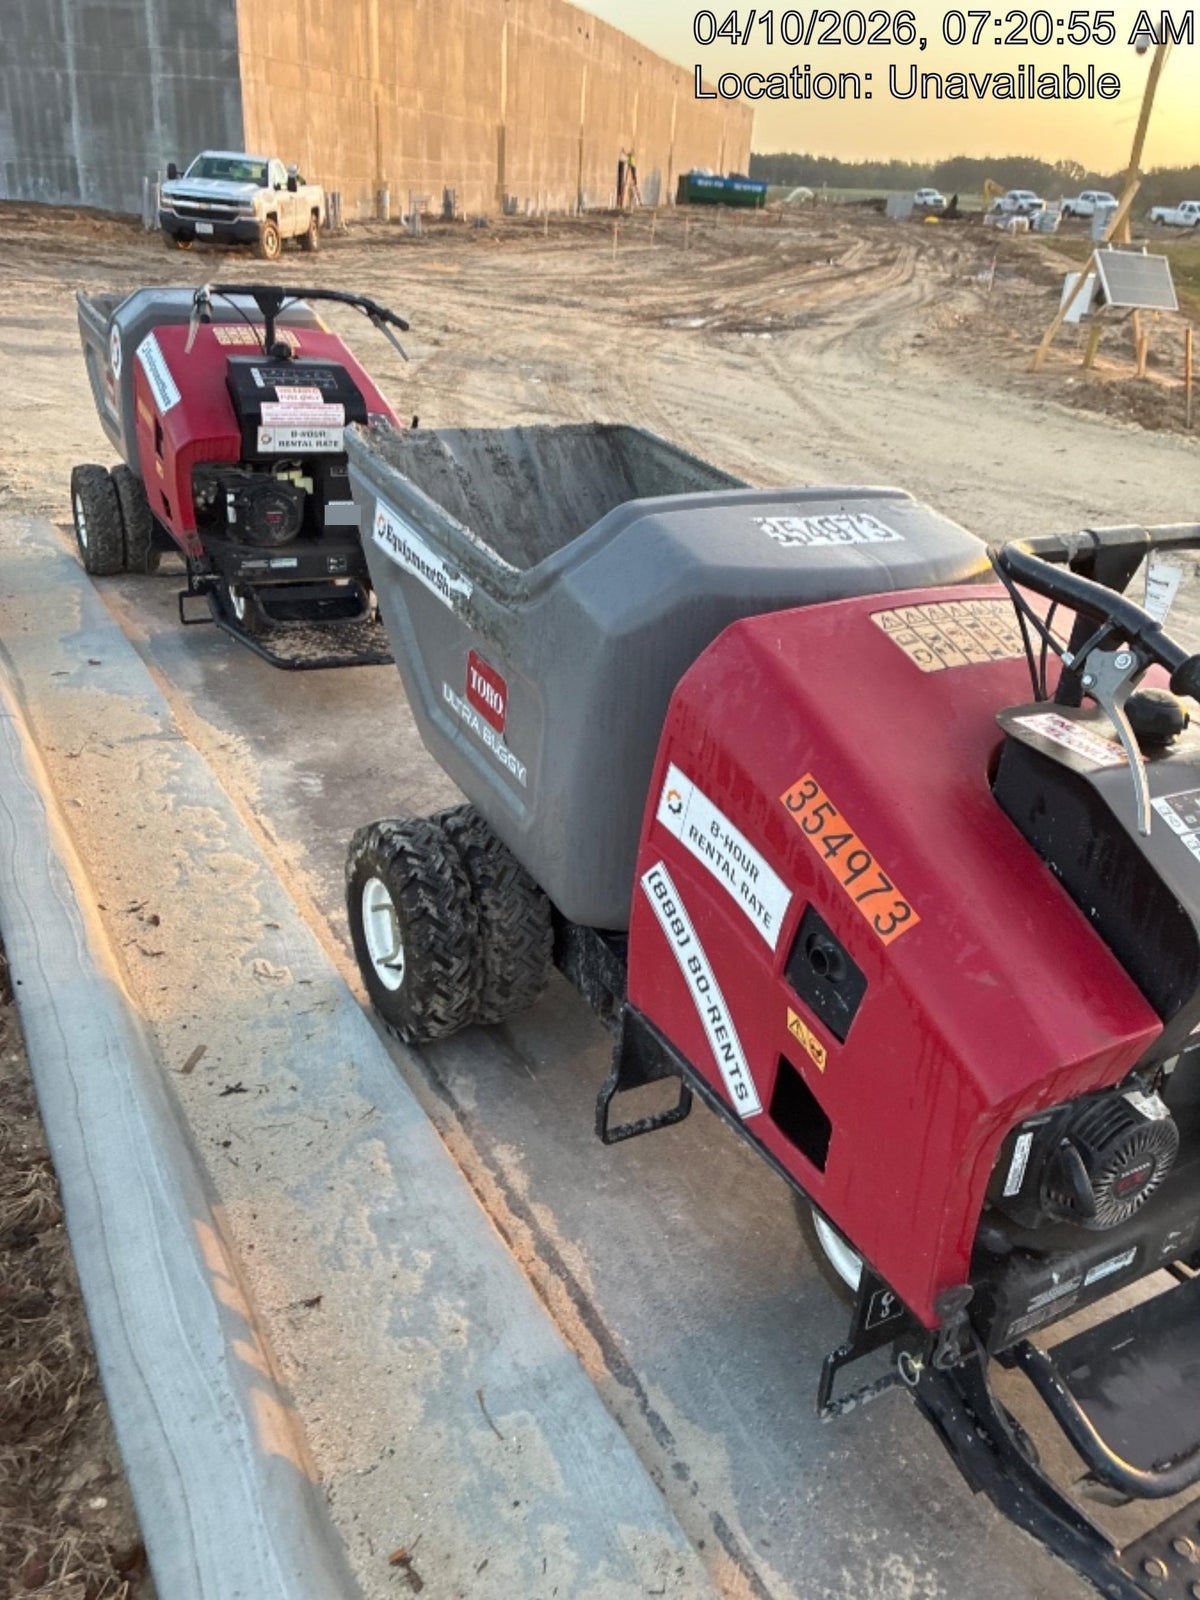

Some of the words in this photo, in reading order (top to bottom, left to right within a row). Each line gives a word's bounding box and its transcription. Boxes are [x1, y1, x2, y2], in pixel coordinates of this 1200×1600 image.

[278, 440, 313, 448] RENTAL
[315, 440, 339, 448] RATE
[386, 523, 450, 598] EquipmentSh
[442, 680, 482, 737] ULTRA
[482, 725, 527, 784] BUGGY
[470, 665, 504, 716] TORO
[688, 824, 737, 886] RENTAL
[740, 881, 773, 930] RATE
[709, 819, 761, 883] 8-HOUR
[785, 780, 912, 936] 354973
[648, 870, 691, 947] (888)
[686, 955, 749, 1101] 80-RENTS
